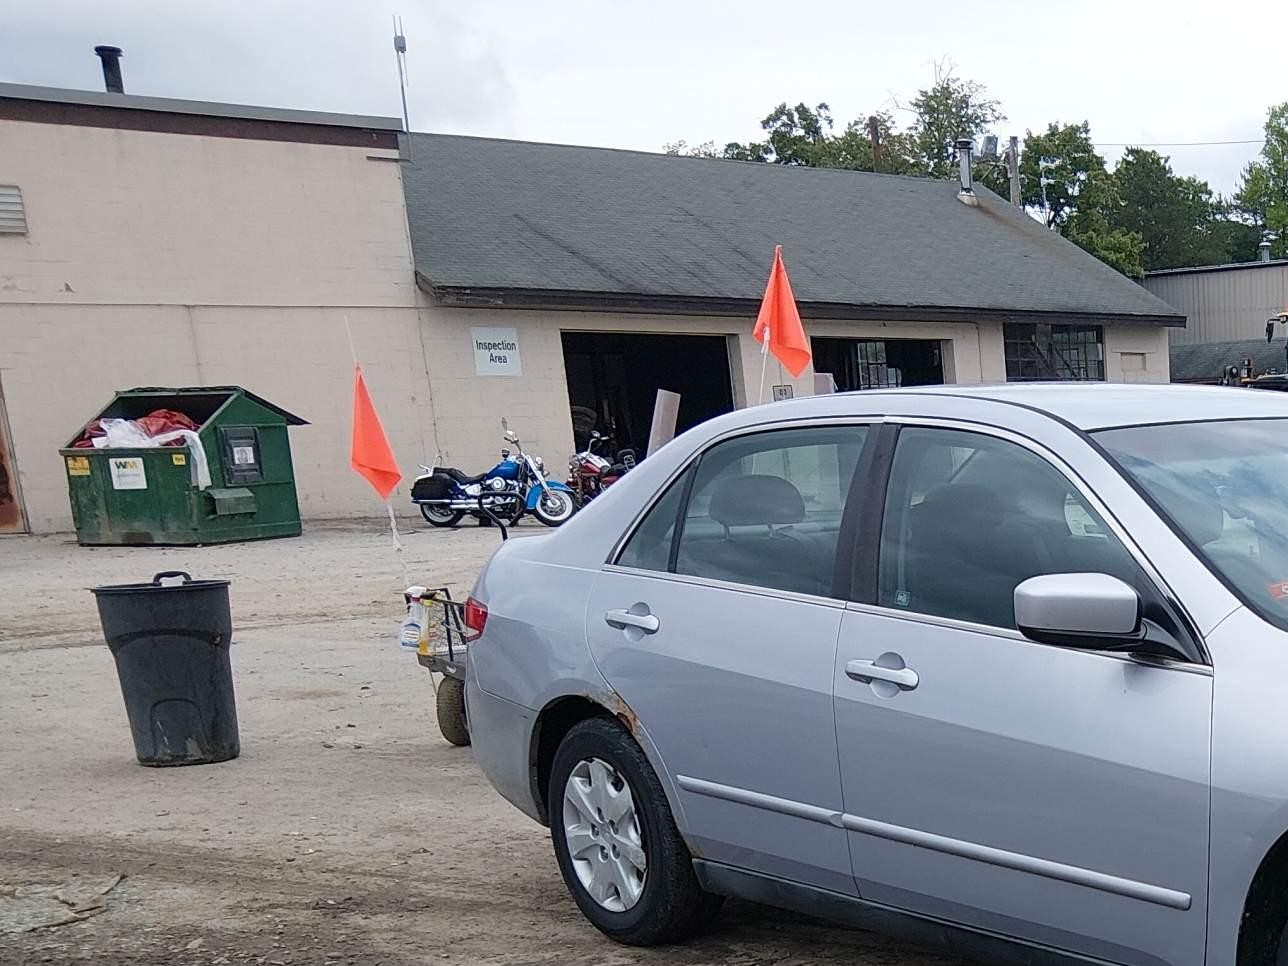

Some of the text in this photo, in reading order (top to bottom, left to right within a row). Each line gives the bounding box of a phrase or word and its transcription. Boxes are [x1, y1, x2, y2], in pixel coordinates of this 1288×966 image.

[475, 340, 517, 352] Inspection
[489, 353, 508, 364] Area
[115, 461, 138, 469] WM
